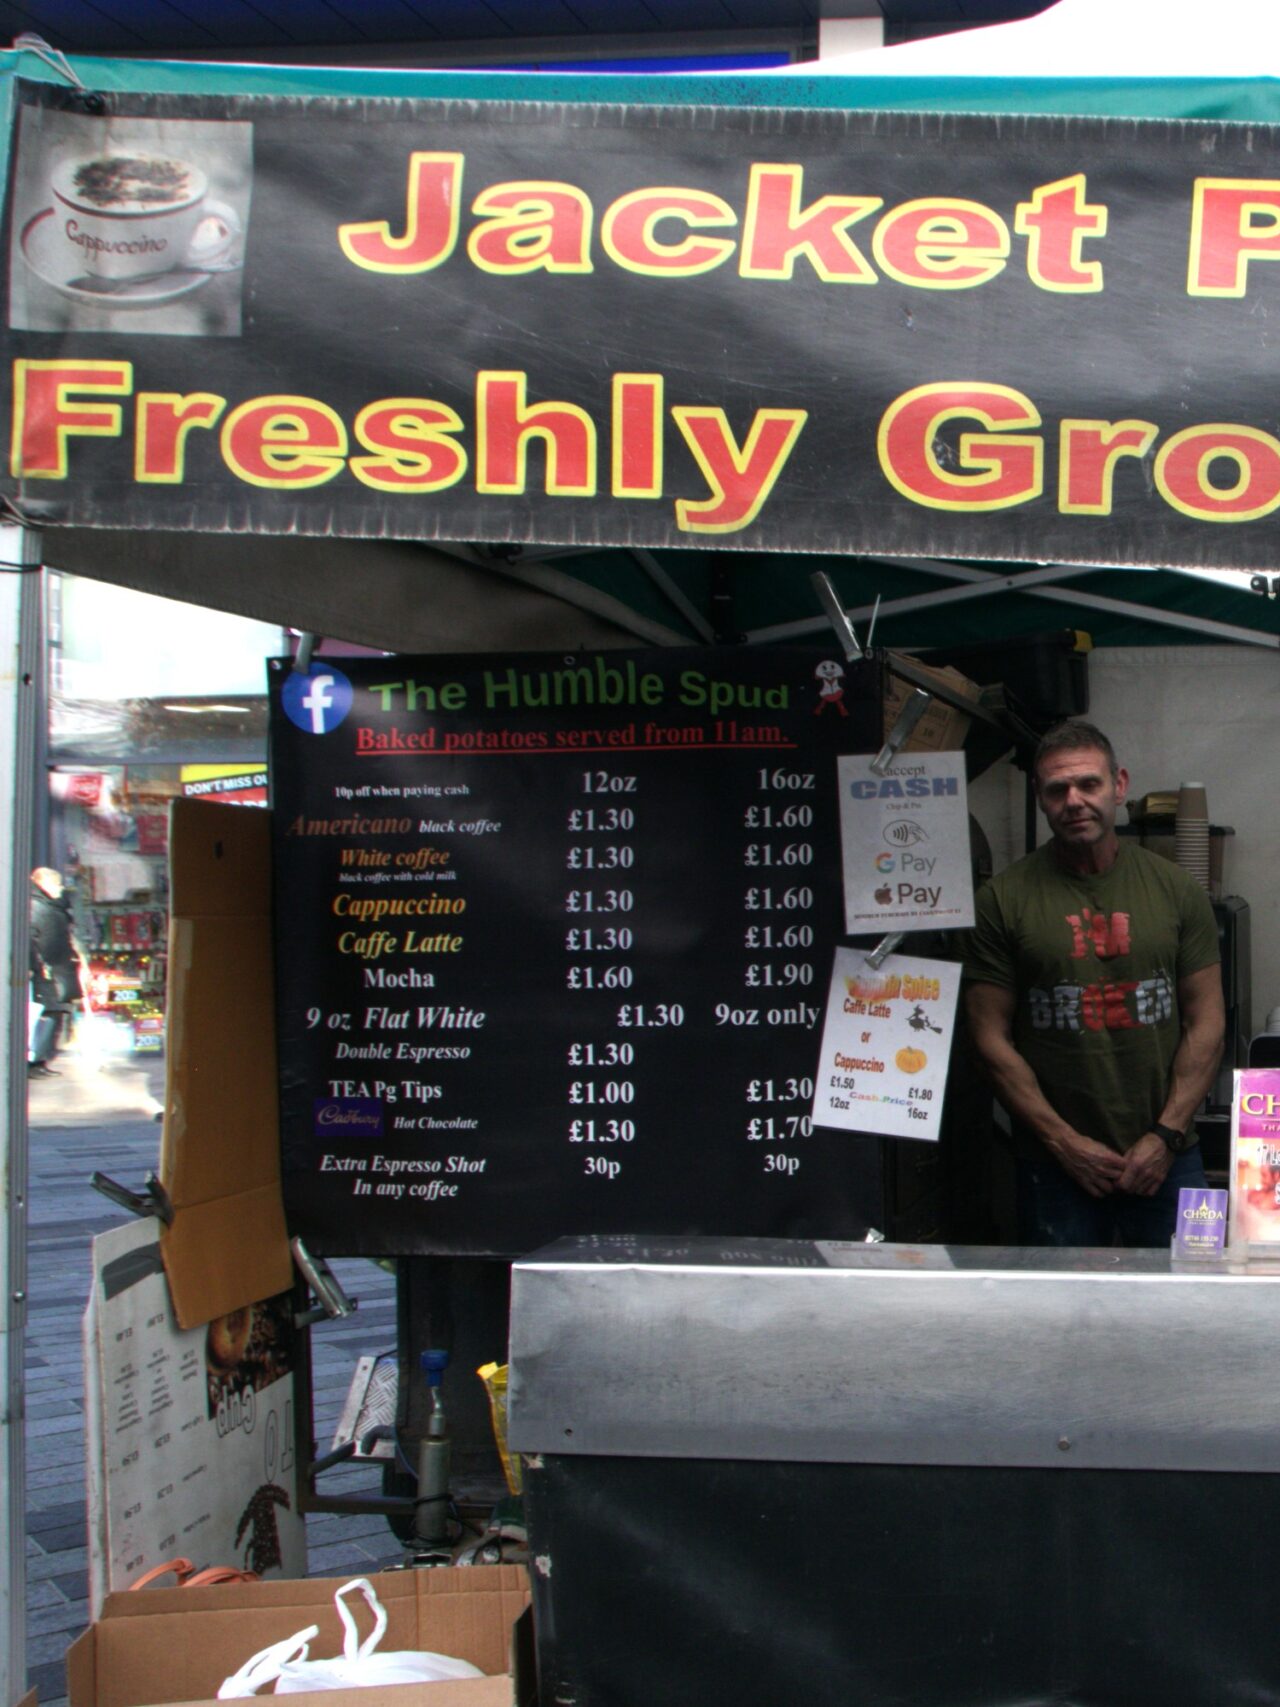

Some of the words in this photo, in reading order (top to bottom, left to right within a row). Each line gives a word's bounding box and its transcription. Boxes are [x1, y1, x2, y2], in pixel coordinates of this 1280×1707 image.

[337, 151, 1108, 294] Jacket
[65, 219, 168, 262] Cappuccino
[12, 359, 807, 535] Freshly
[368, 680, 467, 712] The
[483, 657, 664, 708] Humble
[680, 670, 789, 715] Spud
[357, 727, 436, 750] Baked
[444, 729, 548, 752] potatoes
[556, 723, 635, 746] served
[644, 722, 704, 744] from
[714, 721, 790, 743] 11am.
[184, 779, 221, 796] DON'T
[223, 775, 252, 791] MISS
[335, 786, 353, 799] 10p
[355, 785, 371, 797] off
[373, 785, 401, 797] when
[403, 785, 441, 798] paying
[444, 784, 470, 796] cash
[582, 770, 638, 793] 12oz
[758, 767, 815, 790] 16oz
[850, 777, 958, 800] CASH
[286, 813, 412, 836] Americano
[419, 819, 455, 833] black
[459, 819, 502, 836] coffee
[568, 808, 634, 831] £1.30
[744, 804, 813, 829] £1.60
[340, 848, 391, 867] White
[395, 847, 450, 870] coffee
[567, 846, 634, 869] £1.30
[744, 843, 813, 867] £1.60
[901, 852, 937, 876] Pay
[414, 871, 434, 882] cold
[436, 870, 457, 881] milk
[333, 892, 466, 922] Cappuccino
[566, 890, 633, 913] £1.30
[744, 887, 813, 910] £1.60
[897, 882, 942, 908] Pay
[338, 931, 397, 959] Caffe
[403, 930, 463, 953] Latte
[565, 928, 633, 951] £1.30
[744, 925, 813, 949] £1.60
[364, 968, 435, 988] Mocha
[567, 966, 633, 989] £1.60
[745, 963, 813, 987] £1.90
[901, 973, 941, 1002] Spice
[306, 1007, 321, 1029] 9
[328, 1013, 351, 1031] oz
[363, 1007, 410, 1029] Flat
[416, 1006, 486, 1029] White
[617, 1004, 685, 1027] £1.30
[714, 1003, 759, 1026] 9oz
[767, 1002, 821, 1029] only
[843, 997, 867, 1016] Caffe
[868, 1001, 891, 1019] Latte
[861, 1031, 871, 1043] or
[336, 1043, 392, 1059] Double
[396, 1043, 471, 1063] Espresso
[568, 1043, 634, 1066] £1.30
[834, 1052, 885, 1073] Cappuccino
[329, 1080, 370, 1098] TEA
[375, 1081, 397, 1103] Pg
[400, 1081, 442, 1103] Tips
[569, 1081, 635, 1104] £1.00
[746, 1077, 813, 1102] £1.30
[830, 1076, 855, 1090] £1.50
[829, 1097, 850, 1109] 12oz
[907, 1107, 928, 1120] 16oz
[317, 1104, 380, 1129] Cadbury
[394, 1116, 415, 1129] Hot
[418, 1117, 479, 1129] Chocolate
[569, 1120, 635, 1142] £1.30
[747, 1115, 813, 1141] £1.70
[320, 1154, 367, 1172] Extra
[371, 1155, 441, 1176] Espresso
[445, 1156, 486, 1174] Shot
[584, 1156, 621, 1179] 30p
[763, 1154, 800, 1176] 30p
[353, 1178, 372, 1195] In
[376, 1182, 405, 1200] any
[409, 1180, 459, 1201] coffee
[1183, 1208, 1223, 1220] CHADA
